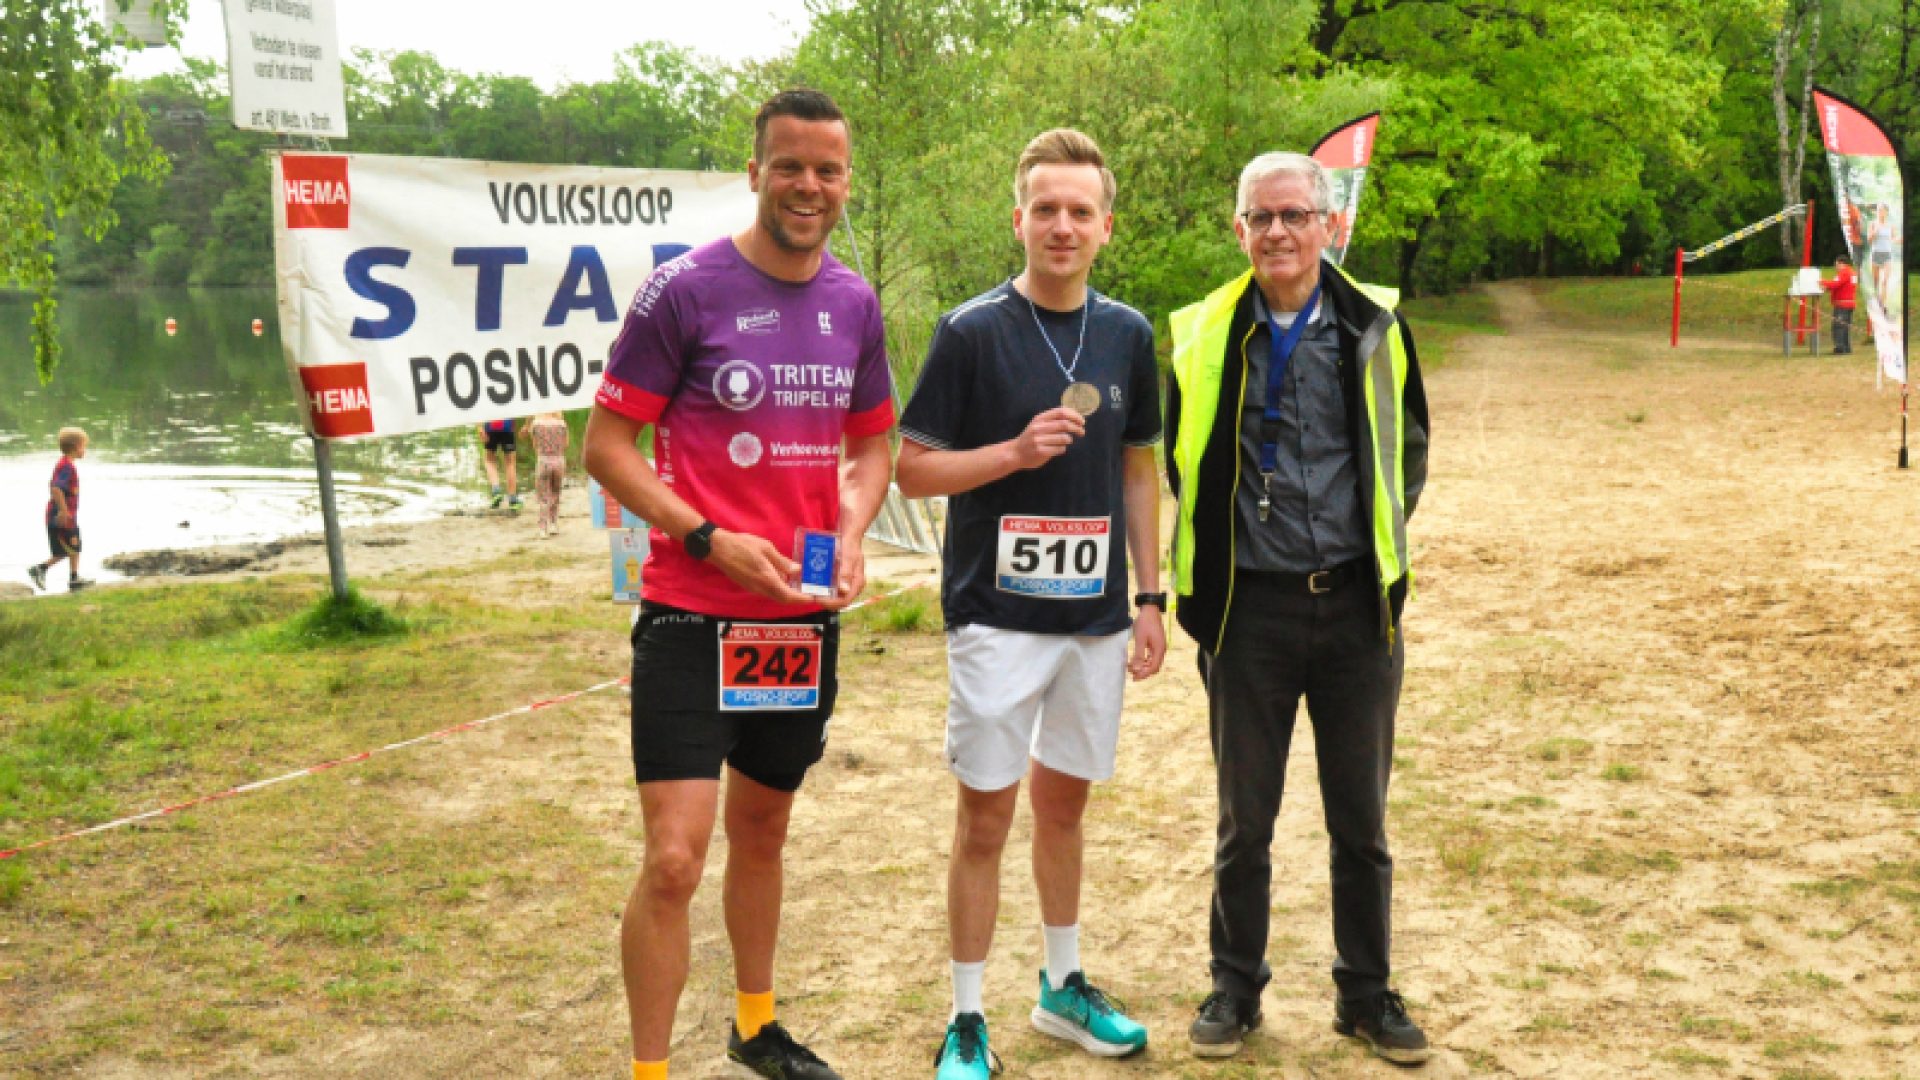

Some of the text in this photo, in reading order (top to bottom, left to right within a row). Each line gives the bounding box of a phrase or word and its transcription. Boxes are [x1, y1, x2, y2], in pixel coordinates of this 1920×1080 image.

[284, 179, 348, 205] HEMA
[488, 180, 674, 226] VOLKSLOOP
[344, 243, 694, 341] STA
[409, 340, 616, 416] POSNO-
[307, 386, 369, 414] HEMA
[772, 390, 830, 407] TRIPEL
[1008, 519, 1106, 533] HEMA VOLKSLOOP
[1010, 537, 1098, 575] 510
[733, 645, 812, 685] 242
